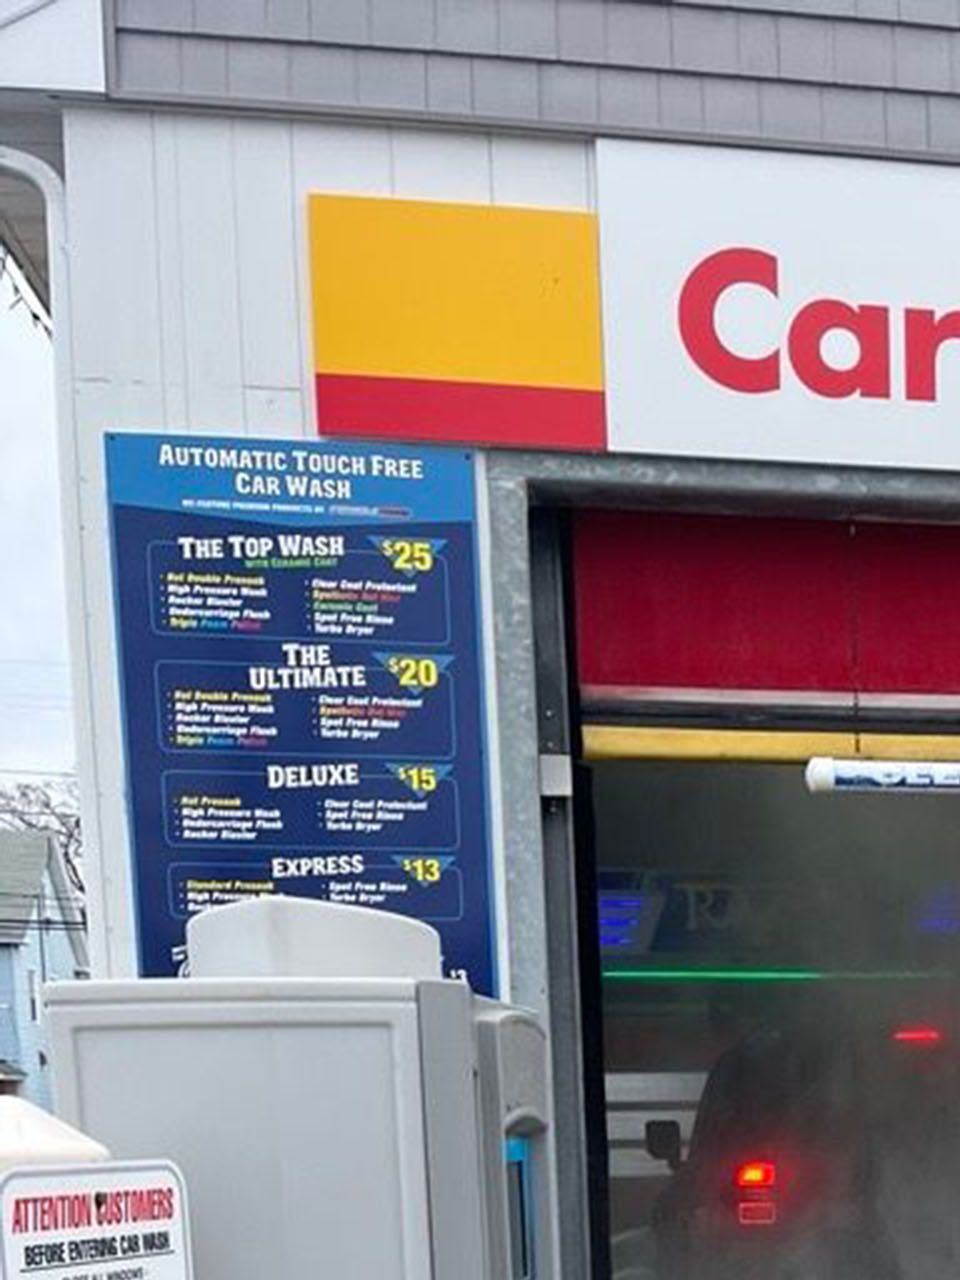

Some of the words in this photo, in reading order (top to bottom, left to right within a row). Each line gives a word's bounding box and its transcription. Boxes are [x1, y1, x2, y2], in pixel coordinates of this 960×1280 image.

[159, 444, 287, 471] AUTOMATIC
[291, 451, 366, 476] TOUCH
[371, 455, 425, 479] FREE
[235, 473, 281, 496] CAR
[285, 475, 351, 499] WASH
[177, 536, 224, 559] THE
[228, 536, 274, 557] TOP
[277, 534, 345, 557] WASH
[381, 538, 434, 571] $25
[314, 624, 342, 634] Turbo
[346, 625, 374, 636] Dryer
[282, 642, 331, 666] THE
[249, 666, 367, 690] ULTIMATE
[388, 655, 439, 687] $20
[267, 764, 359, 788] DELUXE
[398, 766, 437, 791] $15
[272, 854, 365, 879] EXPRESS
[403, 858, 440, 881] $13
[12, 1194, 92, 1234] ATTENTION
[94, 1187, 174, 1226] CUSTOMERS
[24, 1241, 66, 1266] BEFORE
[68, 1236, 118, 1262] ENTERING
[120, 1234, 140, 1256] CAR
[142, 1230, 170, 1252] WASH
